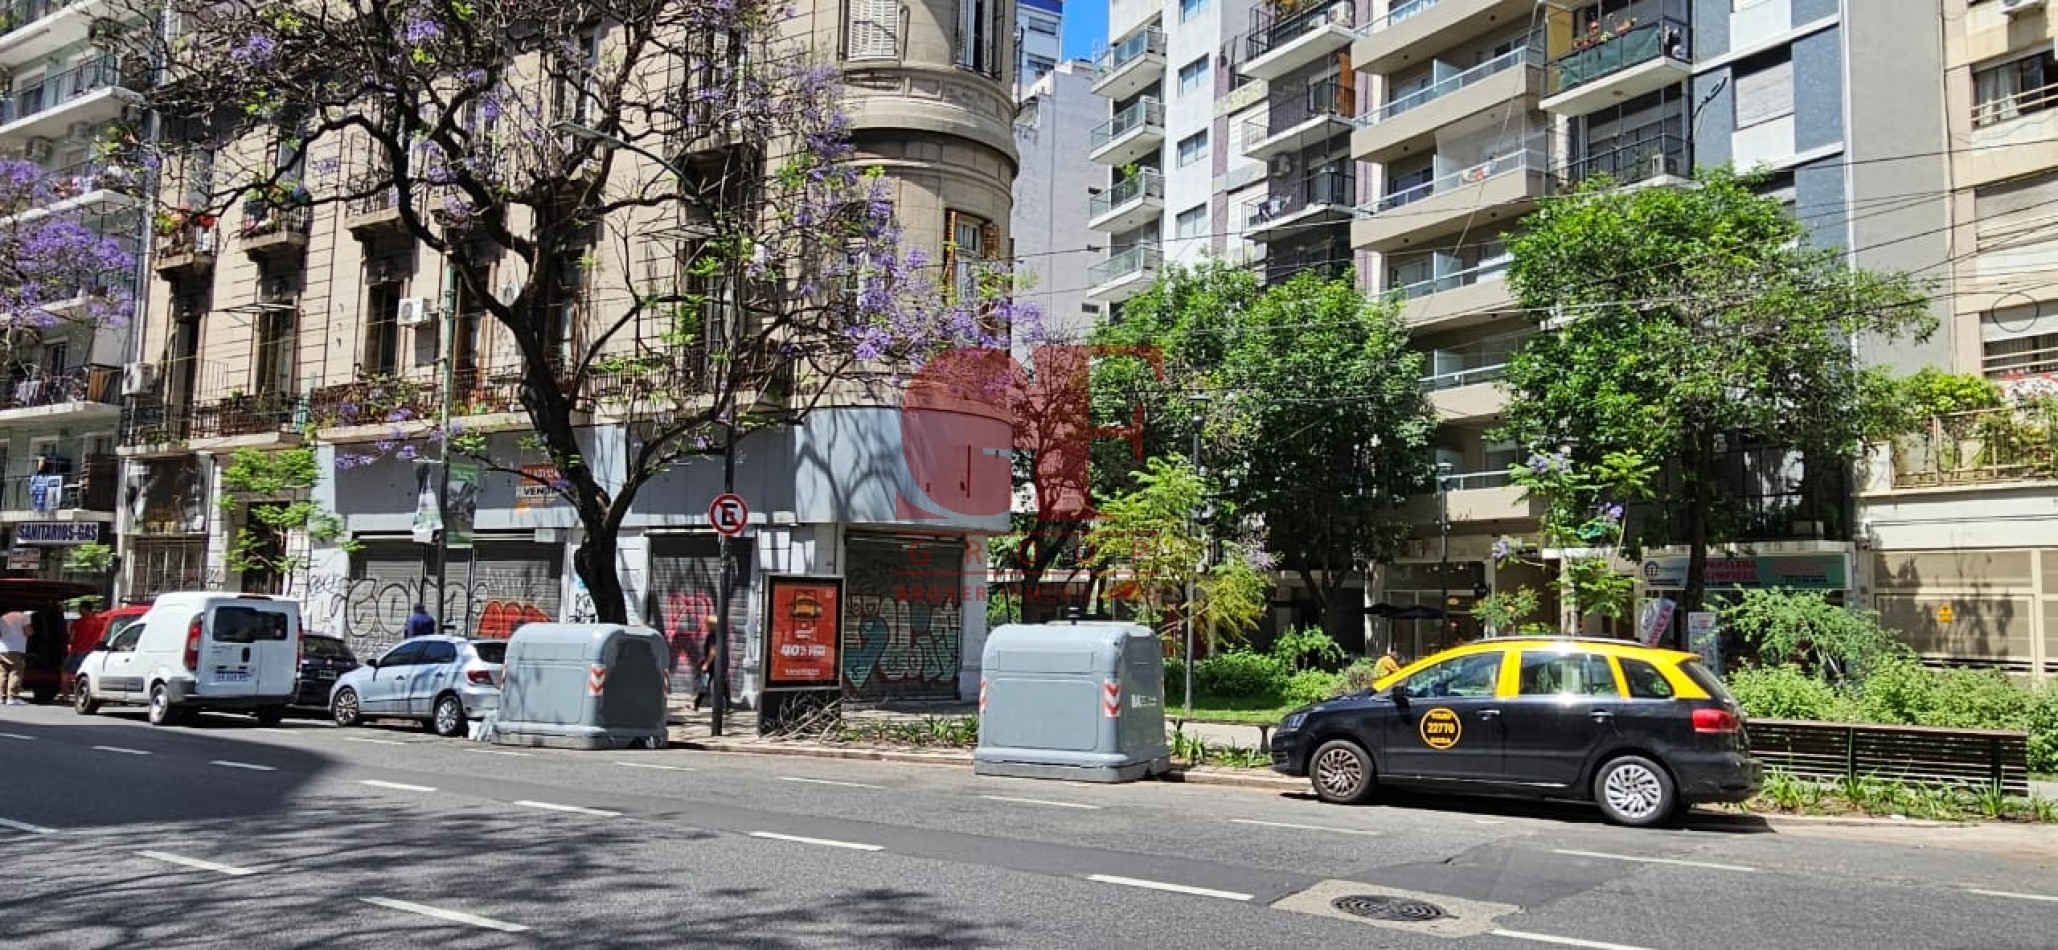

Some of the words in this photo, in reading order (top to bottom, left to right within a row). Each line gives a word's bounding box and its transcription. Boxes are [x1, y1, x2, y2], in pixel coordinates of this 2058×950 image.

[722, 502, 738, 526] E
[18, 523, 97, 540] SANITARIOS-GAS
[1427, 722, 1456, 734] 22770
